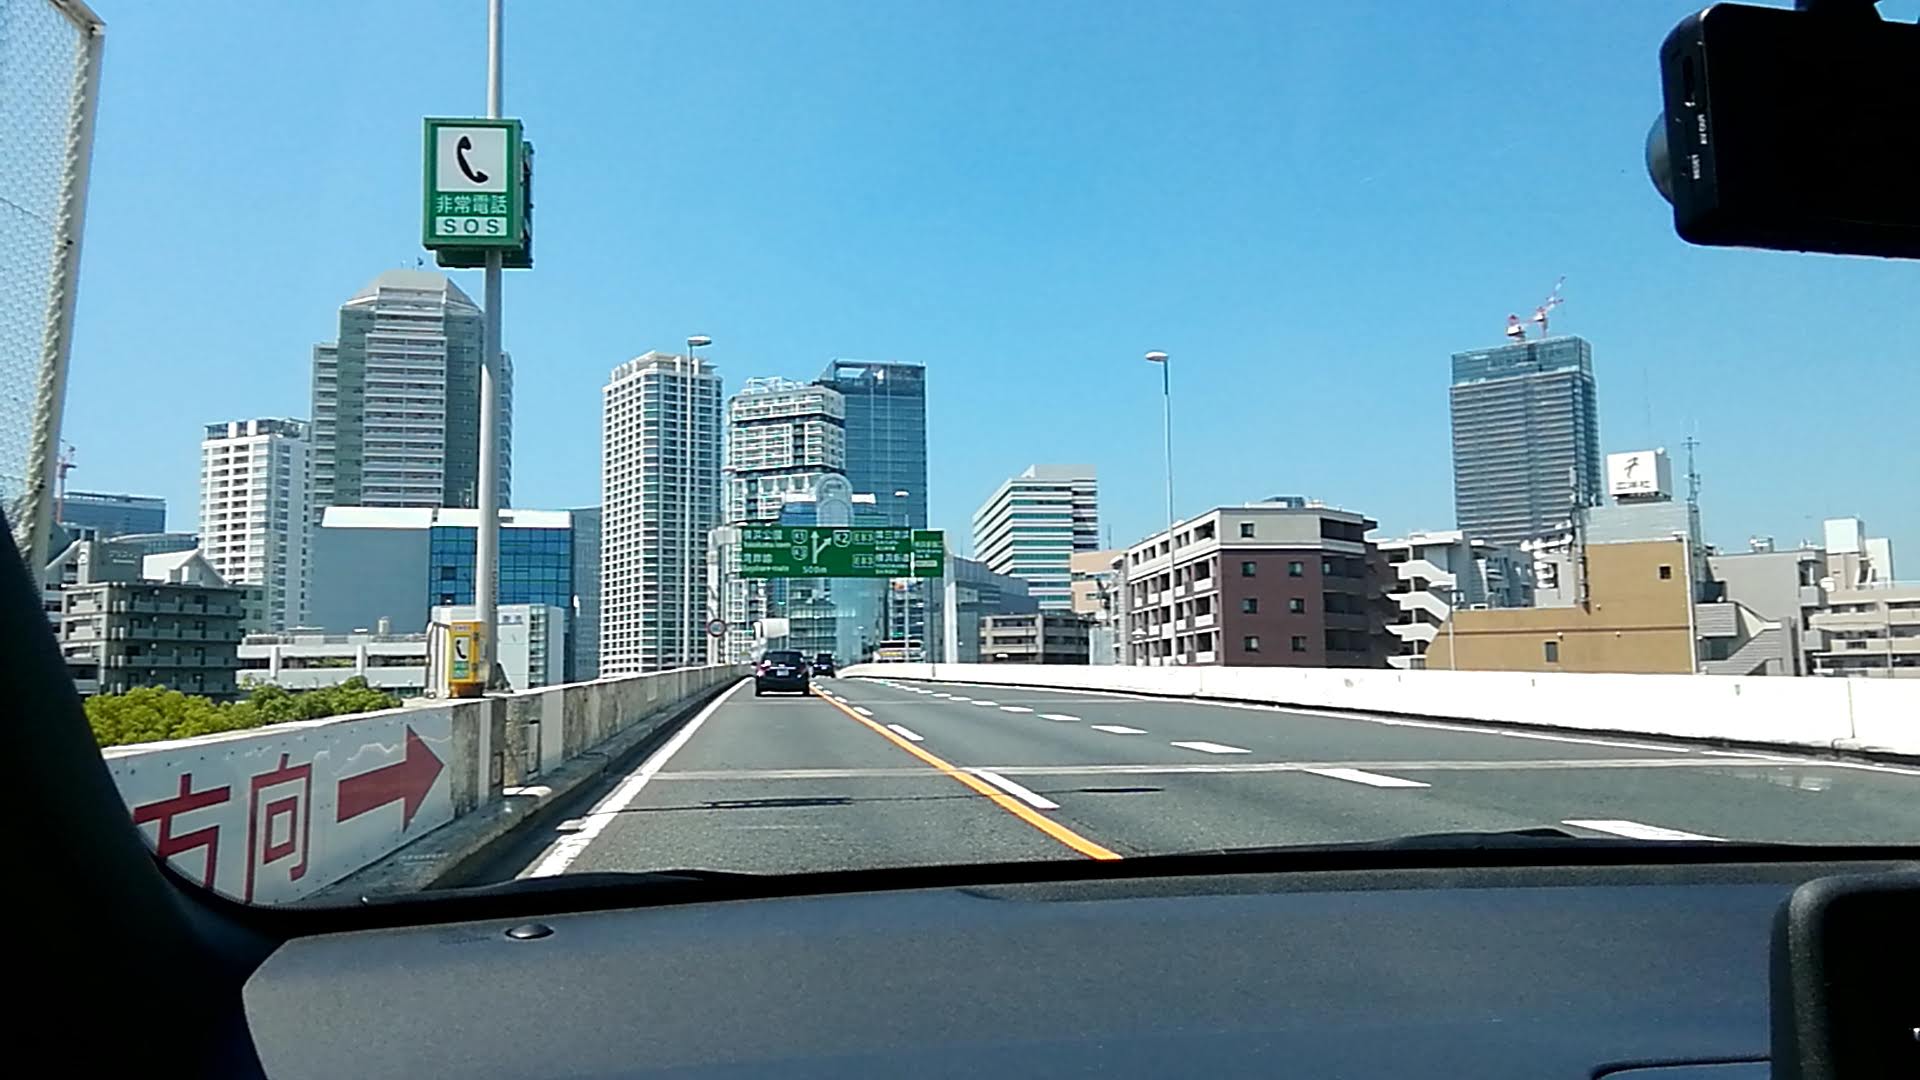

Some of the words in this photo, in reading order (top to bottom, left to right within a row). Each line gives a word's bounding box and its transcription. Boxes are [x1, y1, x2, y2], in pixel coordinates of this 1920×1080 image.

[1692, 154, 1700, 179] RESET
[436, 195, 508, 214] 非常電話
[443, 218, 500, 234] SOS
[802, 566, 828, 574] 500m
[133, 753, 312, 904] 方向
